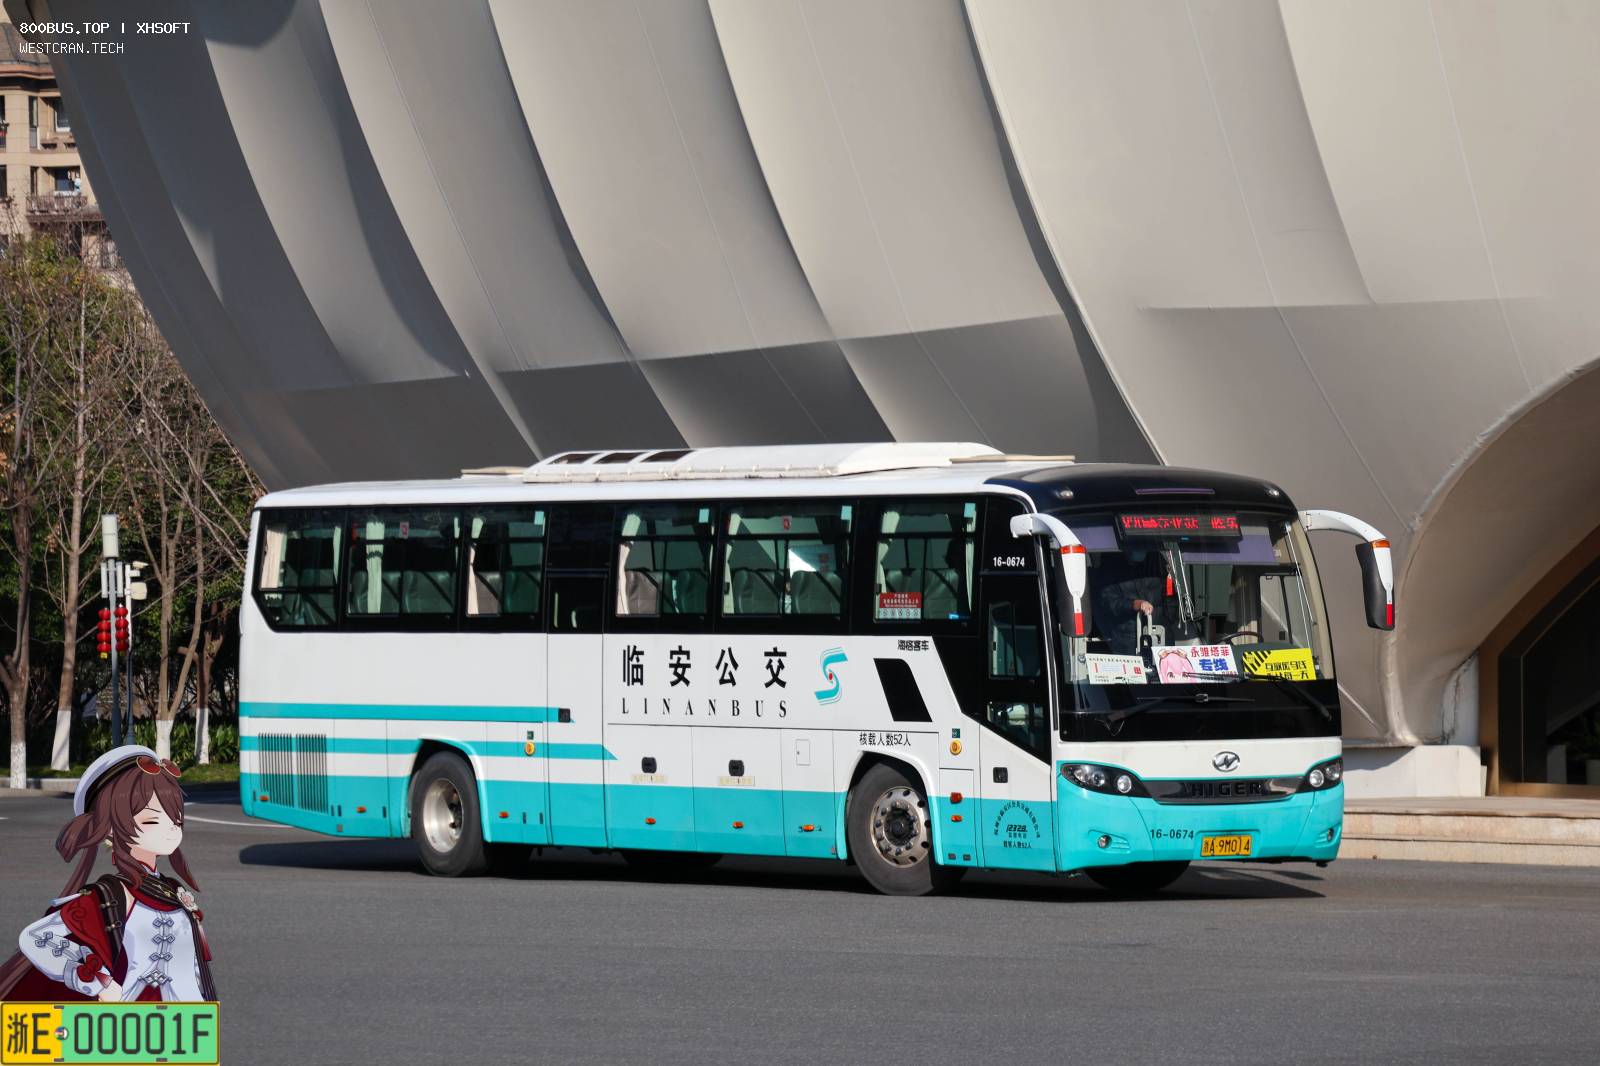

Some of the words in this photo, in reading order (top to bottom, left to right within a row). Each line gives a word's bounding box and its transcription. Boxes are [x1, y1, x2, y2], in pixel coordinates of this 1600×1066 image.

[993, 556, 1025, 567] 16-0674
[622, 644, 788, 689] 临安公交
[1199, 657, 1229, 672] 专线
[621, 697, 788, 719] LINANBUS
[859, 732, 912, 746] 核载人数52人
[1191, 782, 1264, 797] HIGER
[1150, 828, 1195, 841] 16-0674
